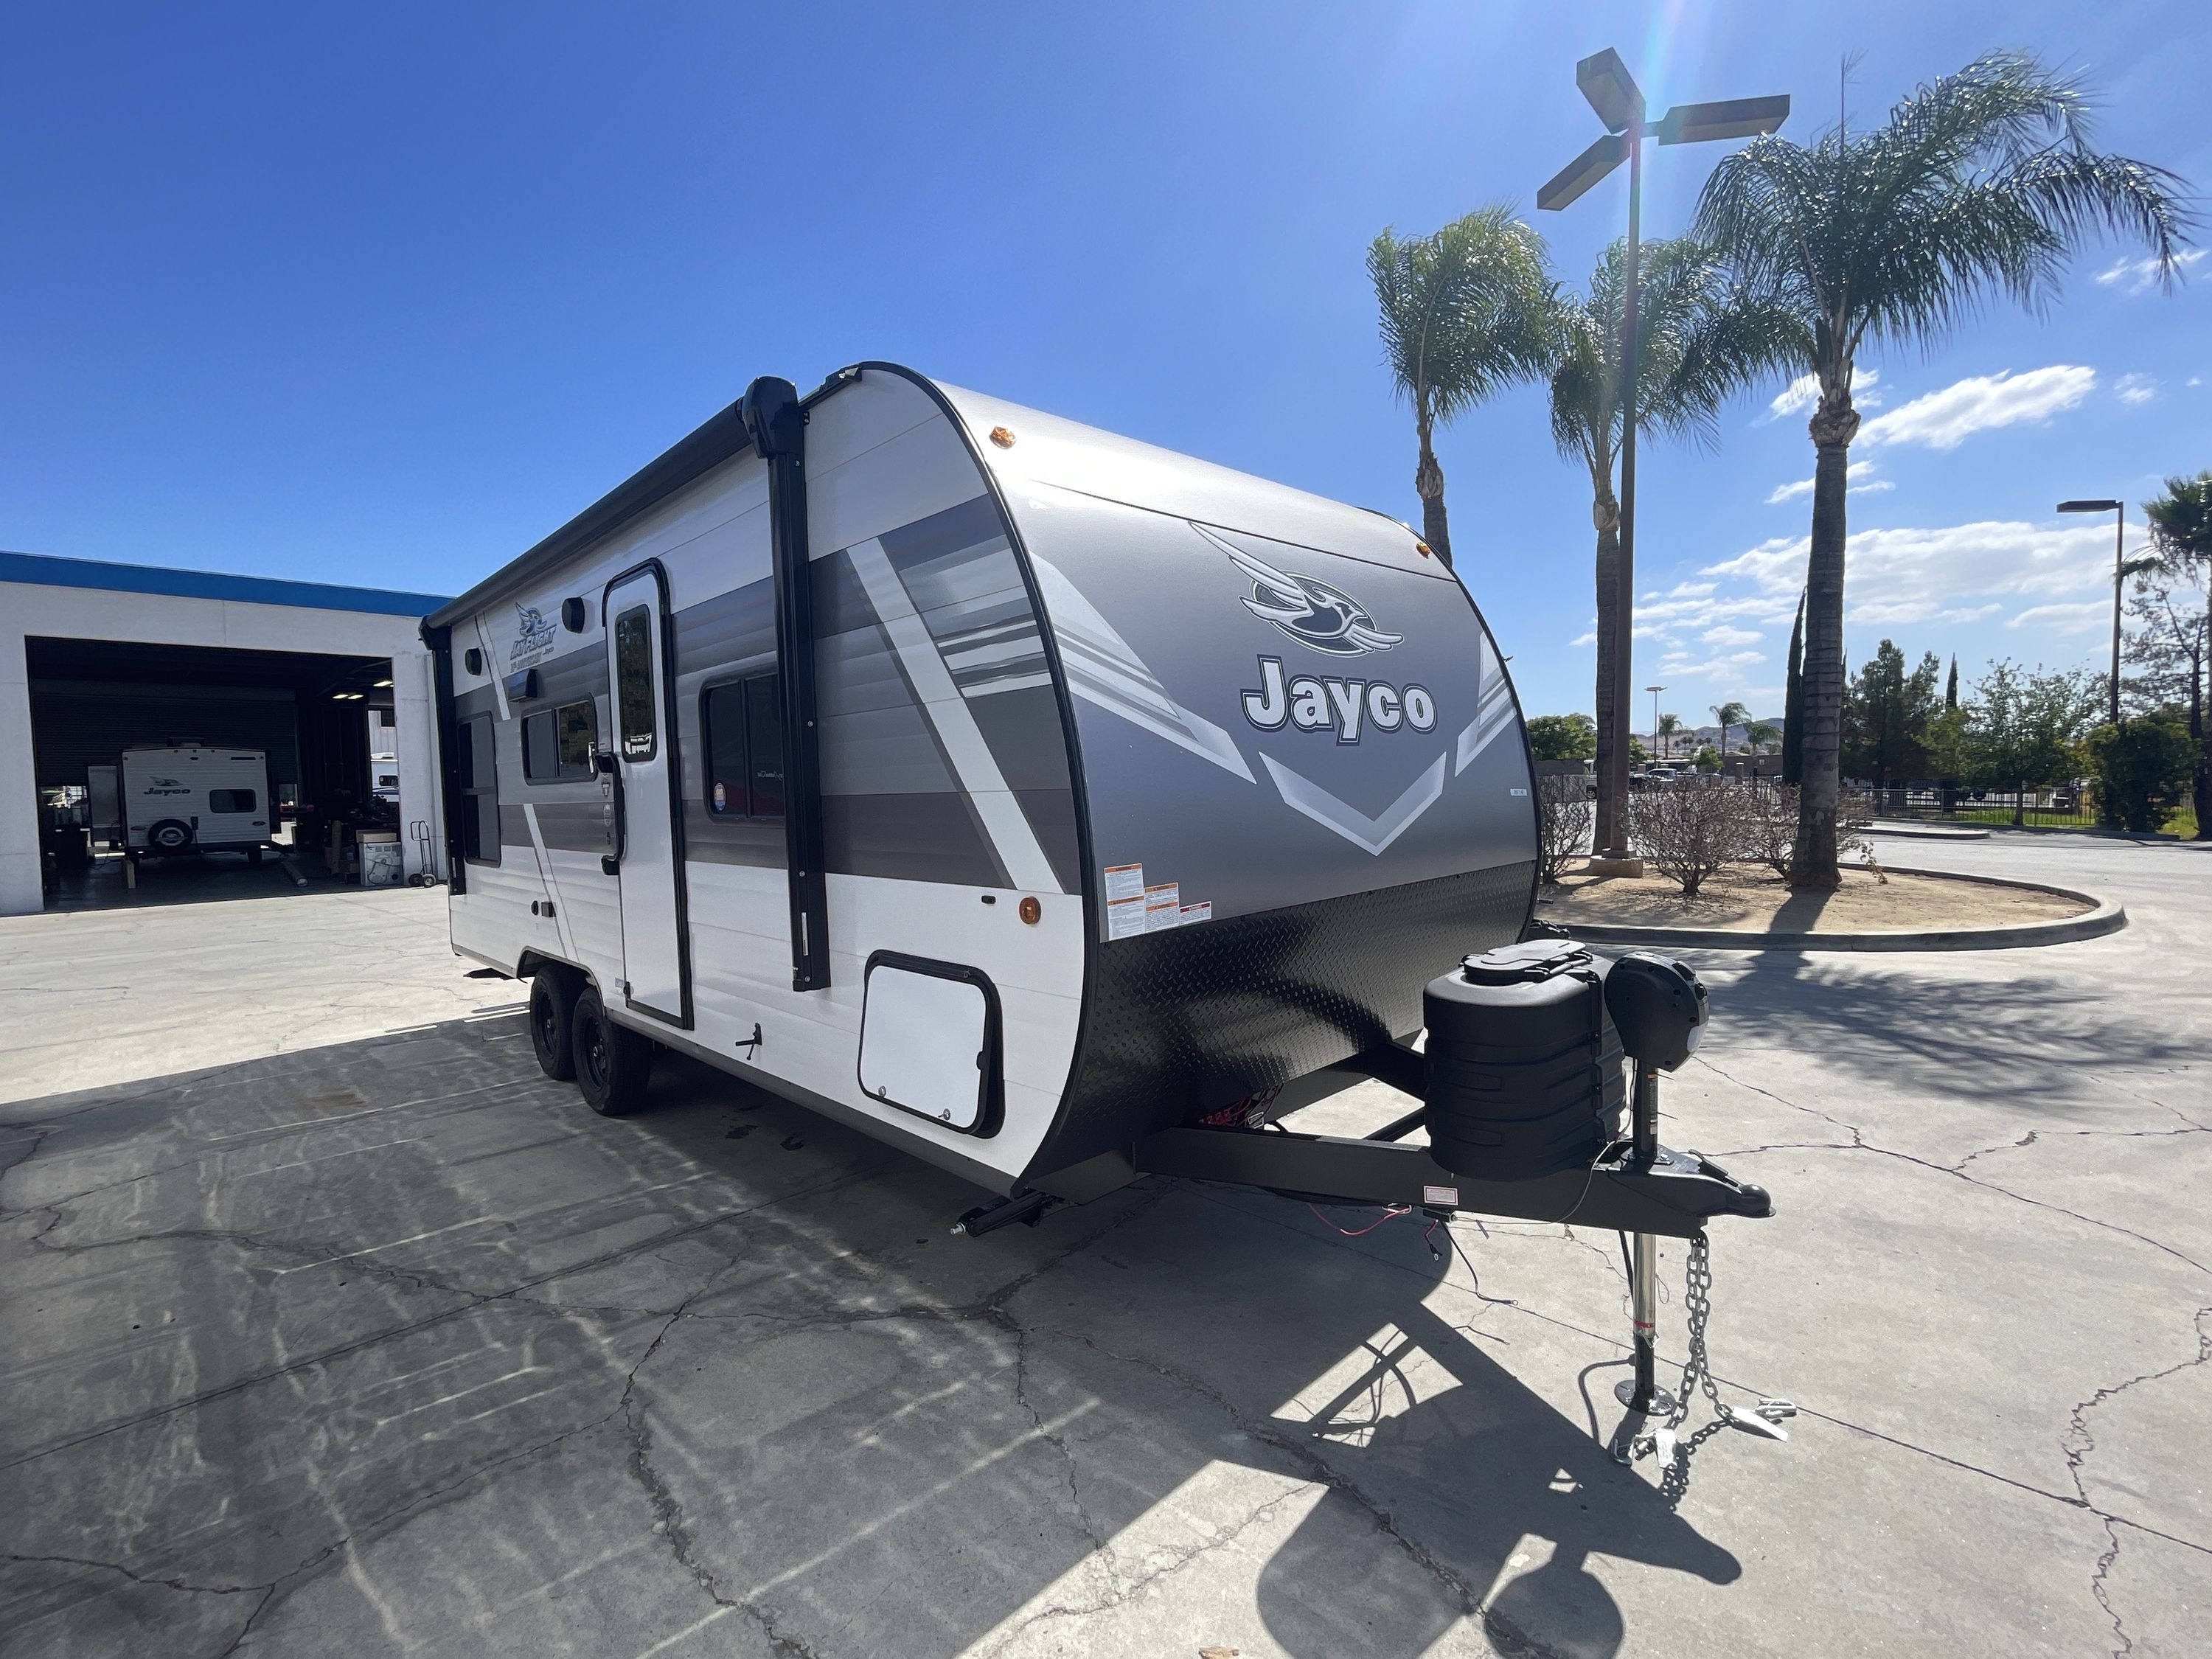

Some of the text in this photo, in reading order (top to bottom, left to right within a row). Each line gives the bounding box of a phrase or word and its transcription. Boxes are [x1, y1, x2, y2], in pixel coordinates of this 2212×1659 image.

[509, 625, 557, 661] JAY FLIGHT
[1240, 653, 1438, 747] Jayco
[144, 787, 190, 796] Jayco
